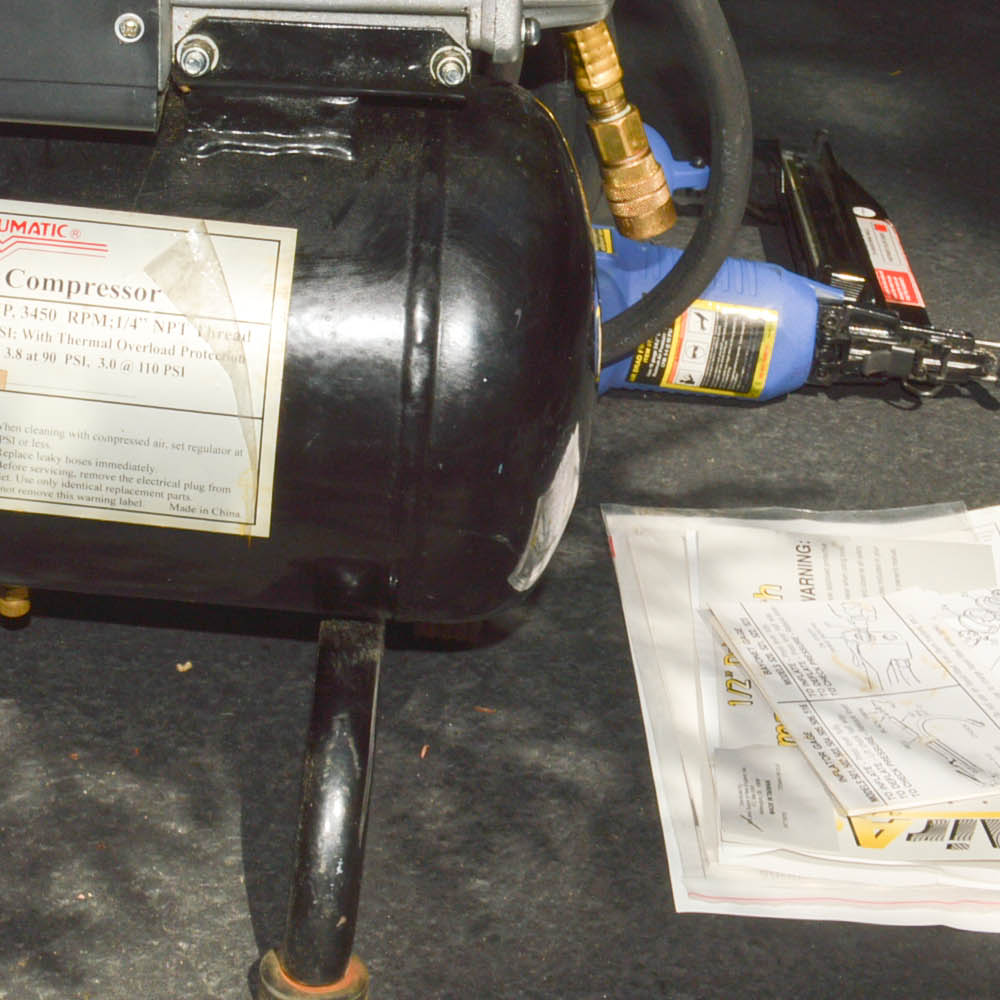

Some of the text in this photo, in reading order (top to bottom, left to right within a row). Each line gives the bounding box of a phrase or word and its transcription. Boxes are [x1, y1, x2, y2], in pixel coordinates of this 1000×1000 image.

[4, 266, 162, 306] Compressor
[19, 305, 56, 324] 3450
[153, 319, 187, 337] NPT
[21, 327, 54, 343] With
[57, 331, 112, 350] Thermal
[115, 337, 175, 357] Overload
[3, 346, 22, 360] 3.8
[24, 349, 38, 362] at
[41, 350, 57, 364] 90
[97, 356, 117, 370] 3.0
[119, 359, 132, 372] @
[137, 360, 158, 375] 110
[162, 363, 186, 378] PSI
[24, 425, 64, 441] cleaning
[67, 429, 90, 441] with
[92, 433, 149, 450] compressed
[170, 441, 184, 451] set
[187, 442, 230, 459] regulator
[233, 448, 243, 457] at
[30, 450, 60, 464] leaky
[65, 454, 92, 467] hoses
[15, 474, 35, 486] Use
[36, 477, 57, 490] only
[60, 479, 102, 493] identical
[104, 484, 163, 501] replacement
[80, 471, 114, 482] remove
[118, 473, 133, 484] the
[136, 474, 180, 489] electrical
[183, 479, 205, 494] plug
[208, 482, 231, 494] from
[17, 488, 53, 499] remove
[55, 490, 74, 501] this
[76, 492, 118, 507] warning
[169, 502, 240, 519] Made in China
